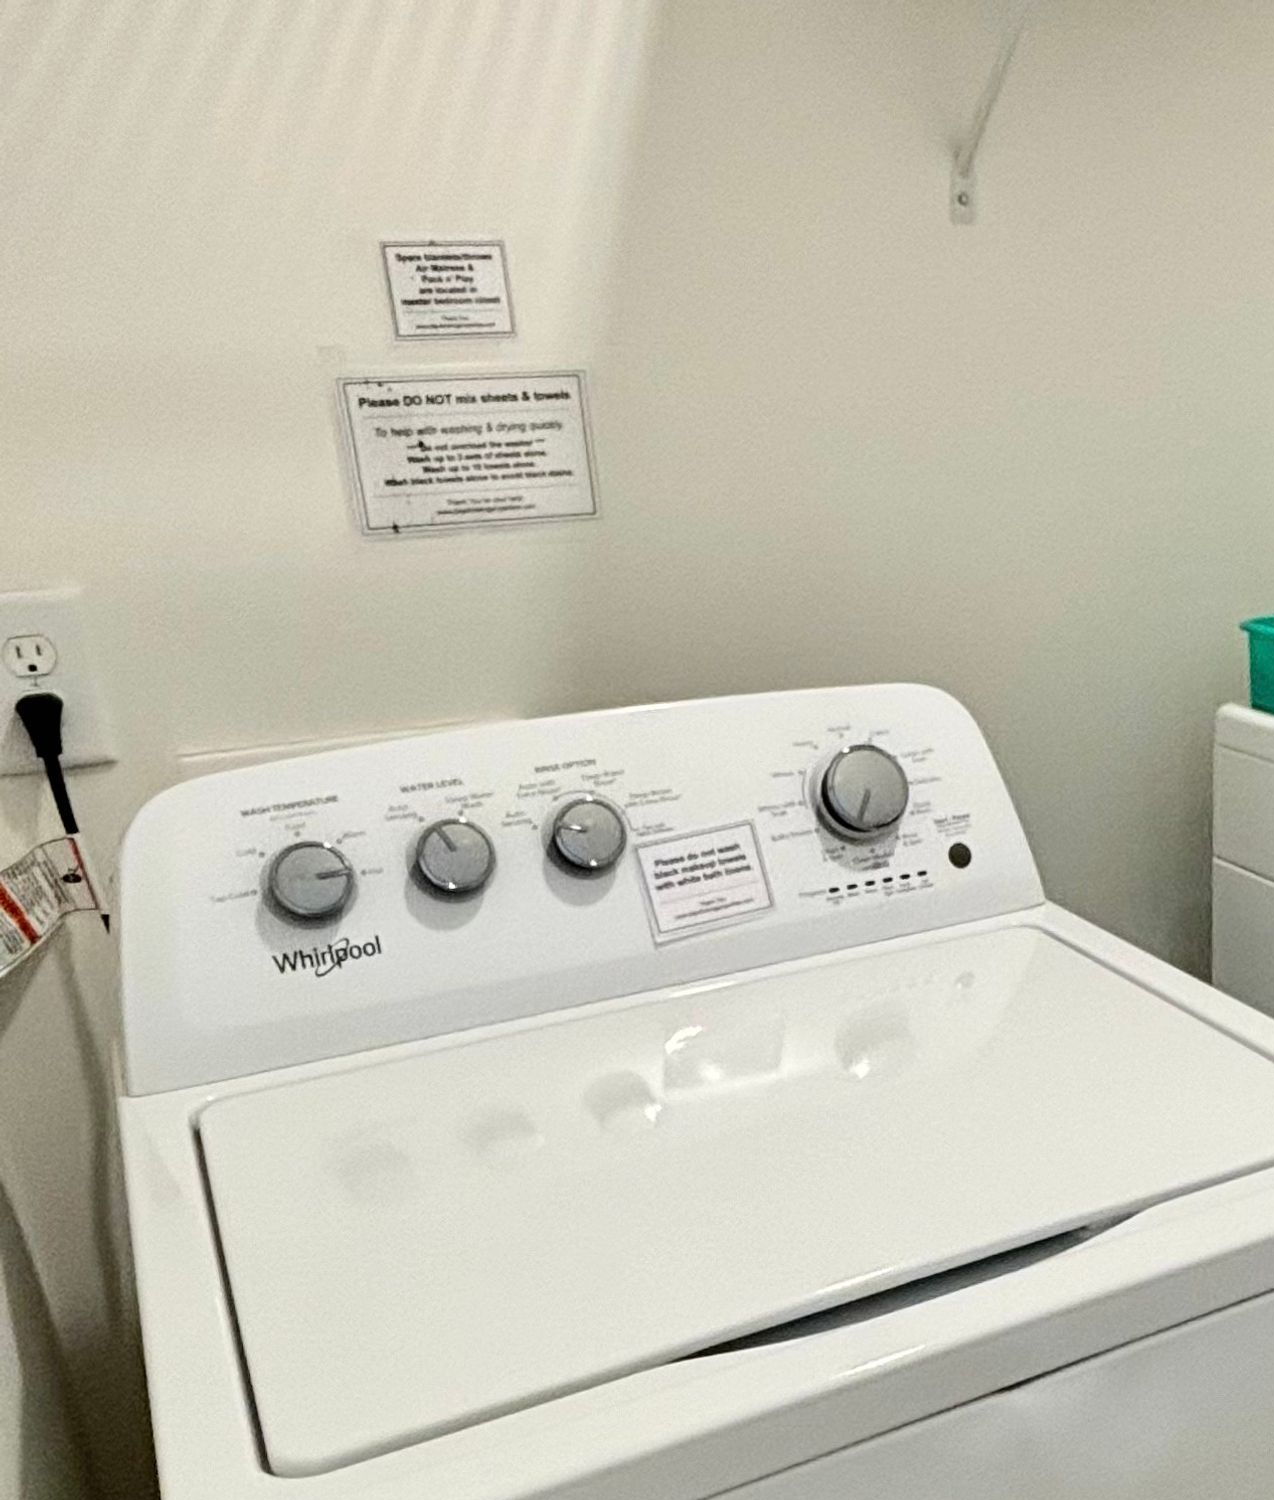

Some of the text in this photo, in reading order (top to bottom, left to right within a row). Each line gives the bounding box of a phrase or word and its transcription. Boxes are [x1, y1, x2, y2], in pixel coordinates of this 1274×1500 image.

[358, 390, 570, 408] Please DO NOT mix sheets & towels
[376, 428, 386, 438] To
[390, 426, 414, 438] help
[417, 426, 436, 436] with
[440, 423, 482, 435] washing
[486, 422, 492, 432] &
[496, 422, 526, 434] drying
[400, 778, 463, 794] WATER LEVEL
[272, 794, 338, 812] TEMPERATURE
[653, 856, 685, 867] Please
[272, 935, 382, 977] Whirlpool
